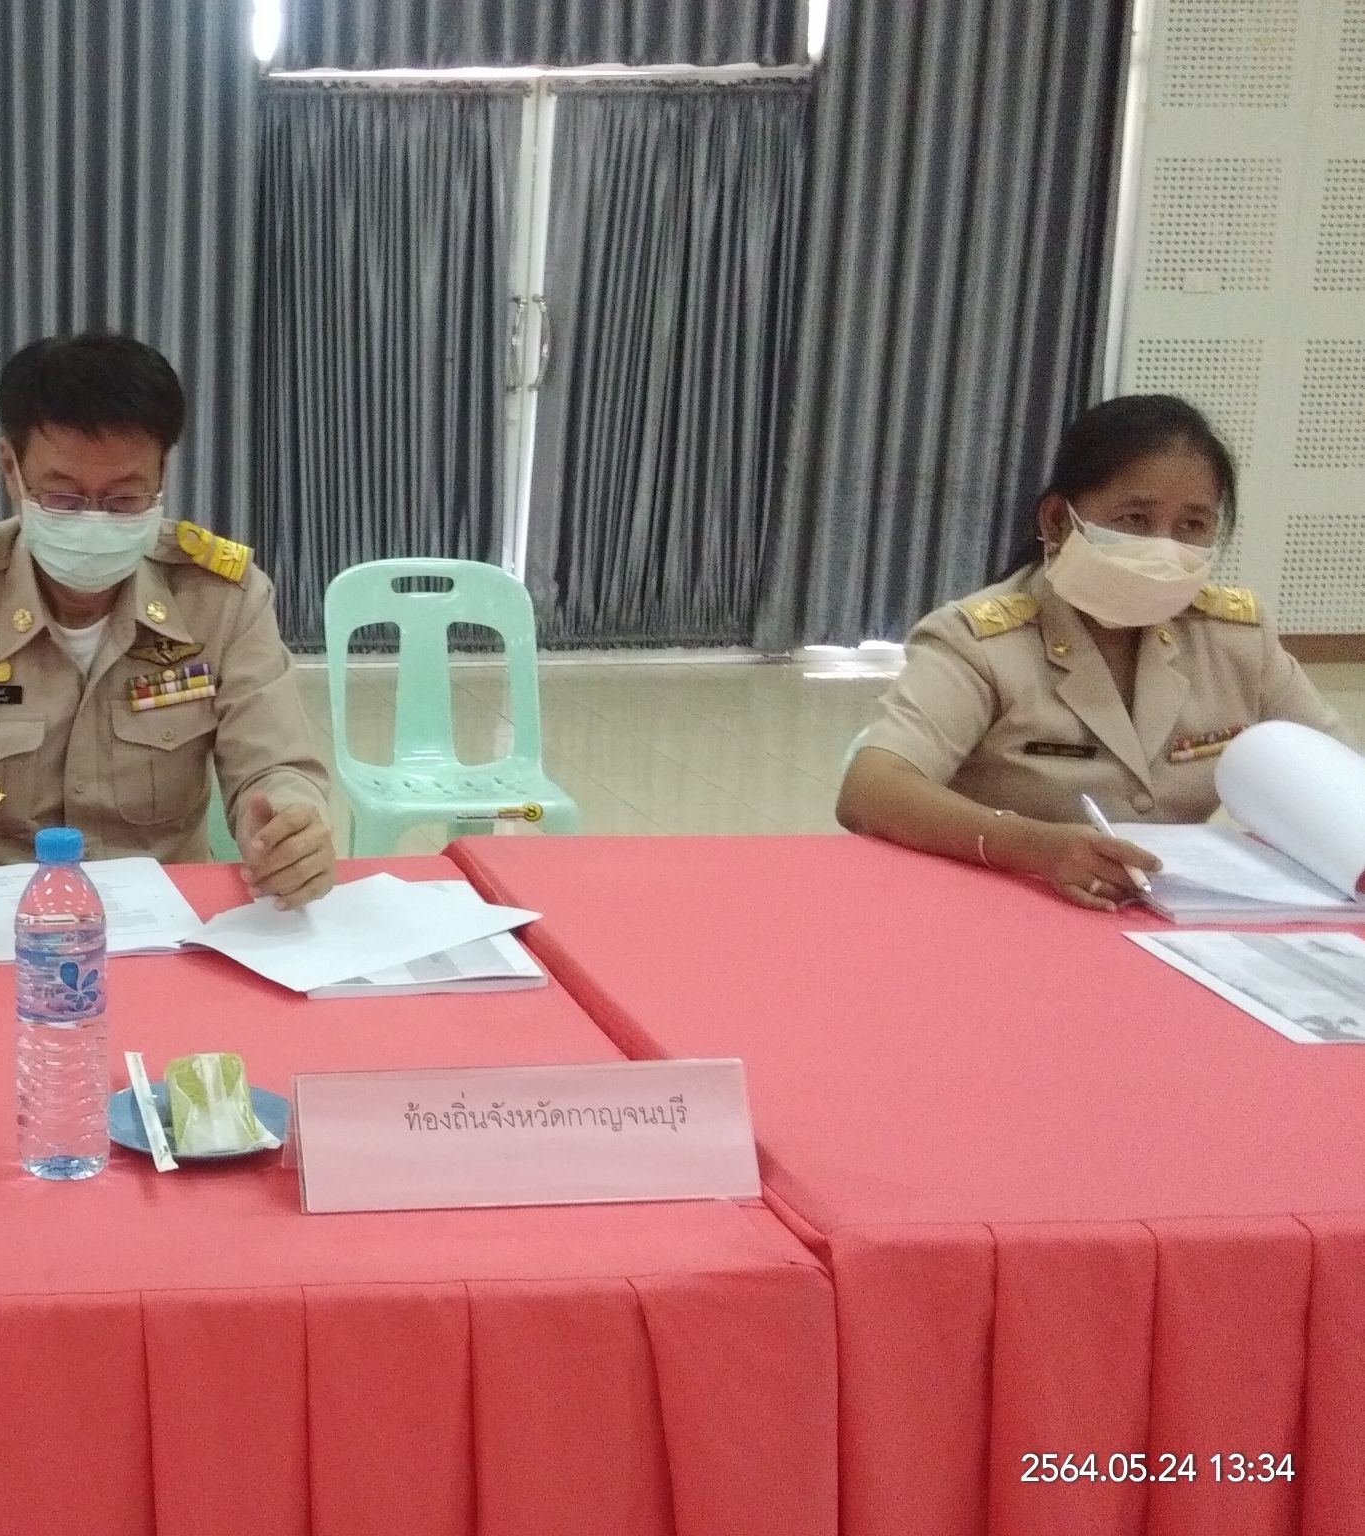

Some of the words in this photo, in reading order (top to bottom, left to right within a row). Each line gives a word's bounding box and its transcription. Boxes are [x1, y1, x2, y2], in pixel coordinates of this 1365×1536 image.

[404, 1091, 688, 1133] ท้องถิ่นจังหวัดกาญจนบุรี
